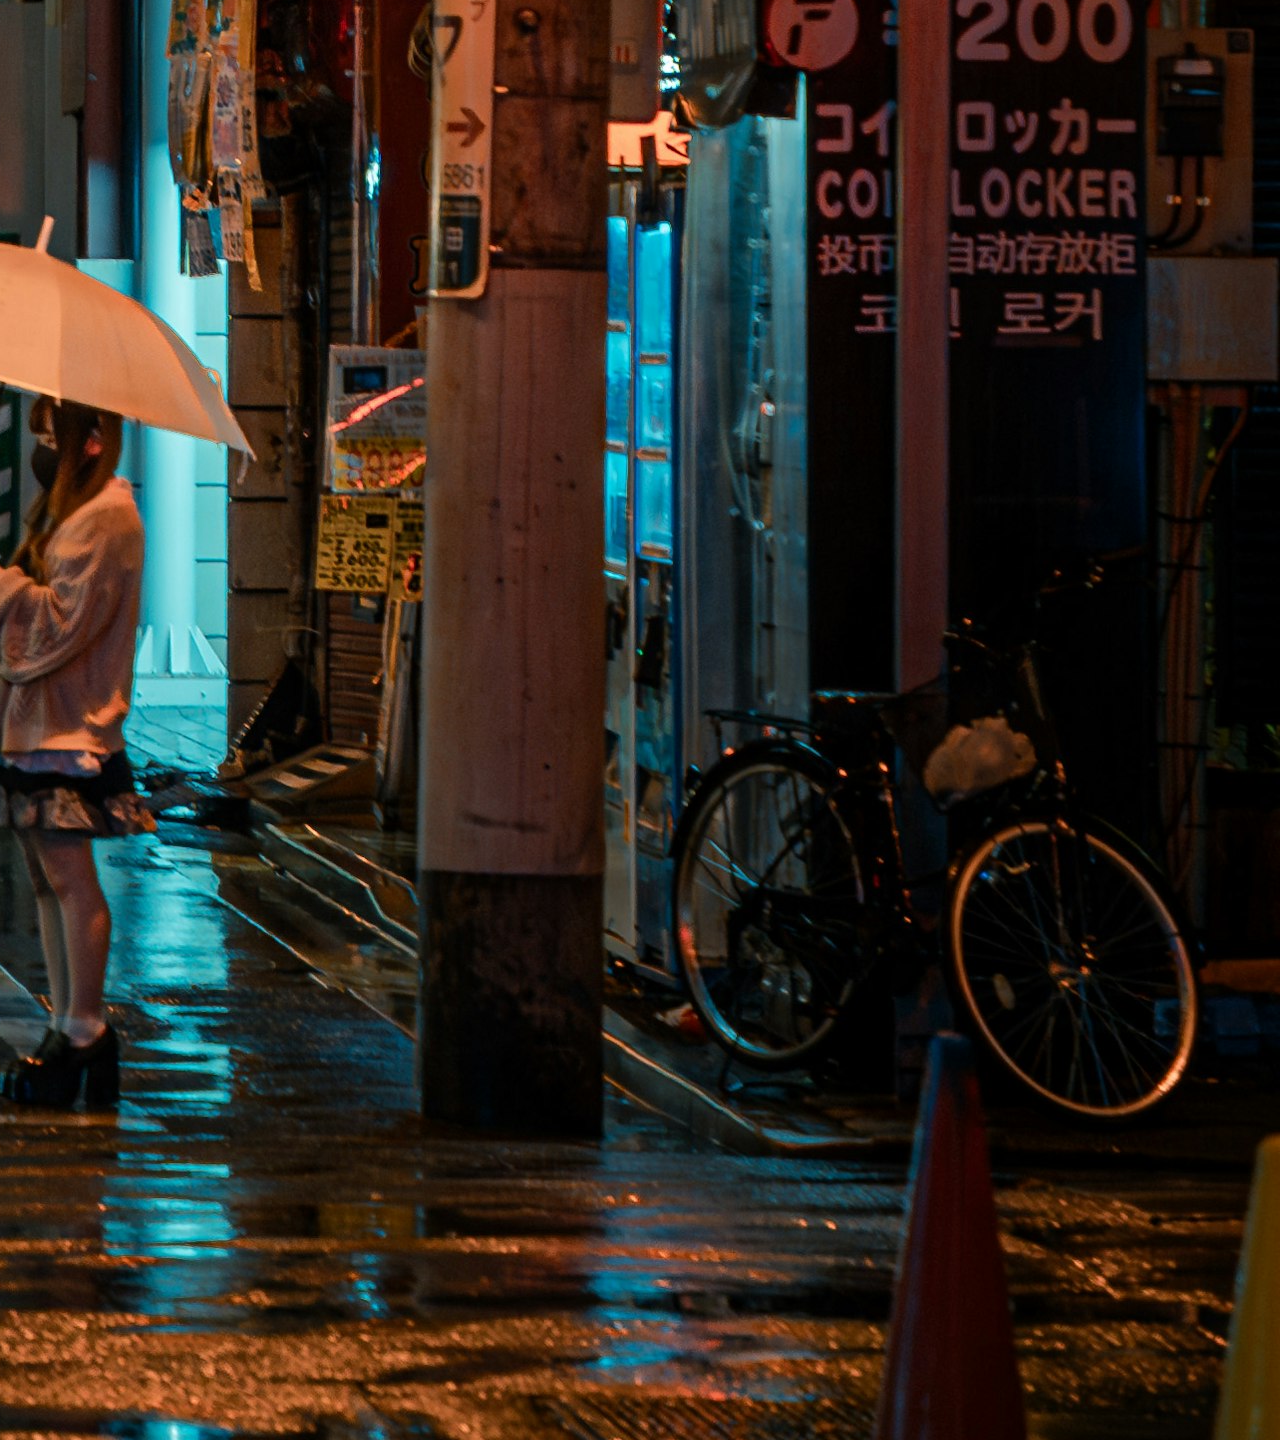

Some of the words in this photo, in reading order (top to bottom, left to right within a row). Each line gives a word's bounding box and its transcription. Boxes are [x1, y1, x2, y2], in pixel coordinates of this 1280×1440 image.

[814, 97, 1138, 158] コイロッカー
[949, 168, 1138, 220] LOCKER
[814, 230, 1138, 276] 投币自动存放柜
[996, 287, 1105, 342] 로커
